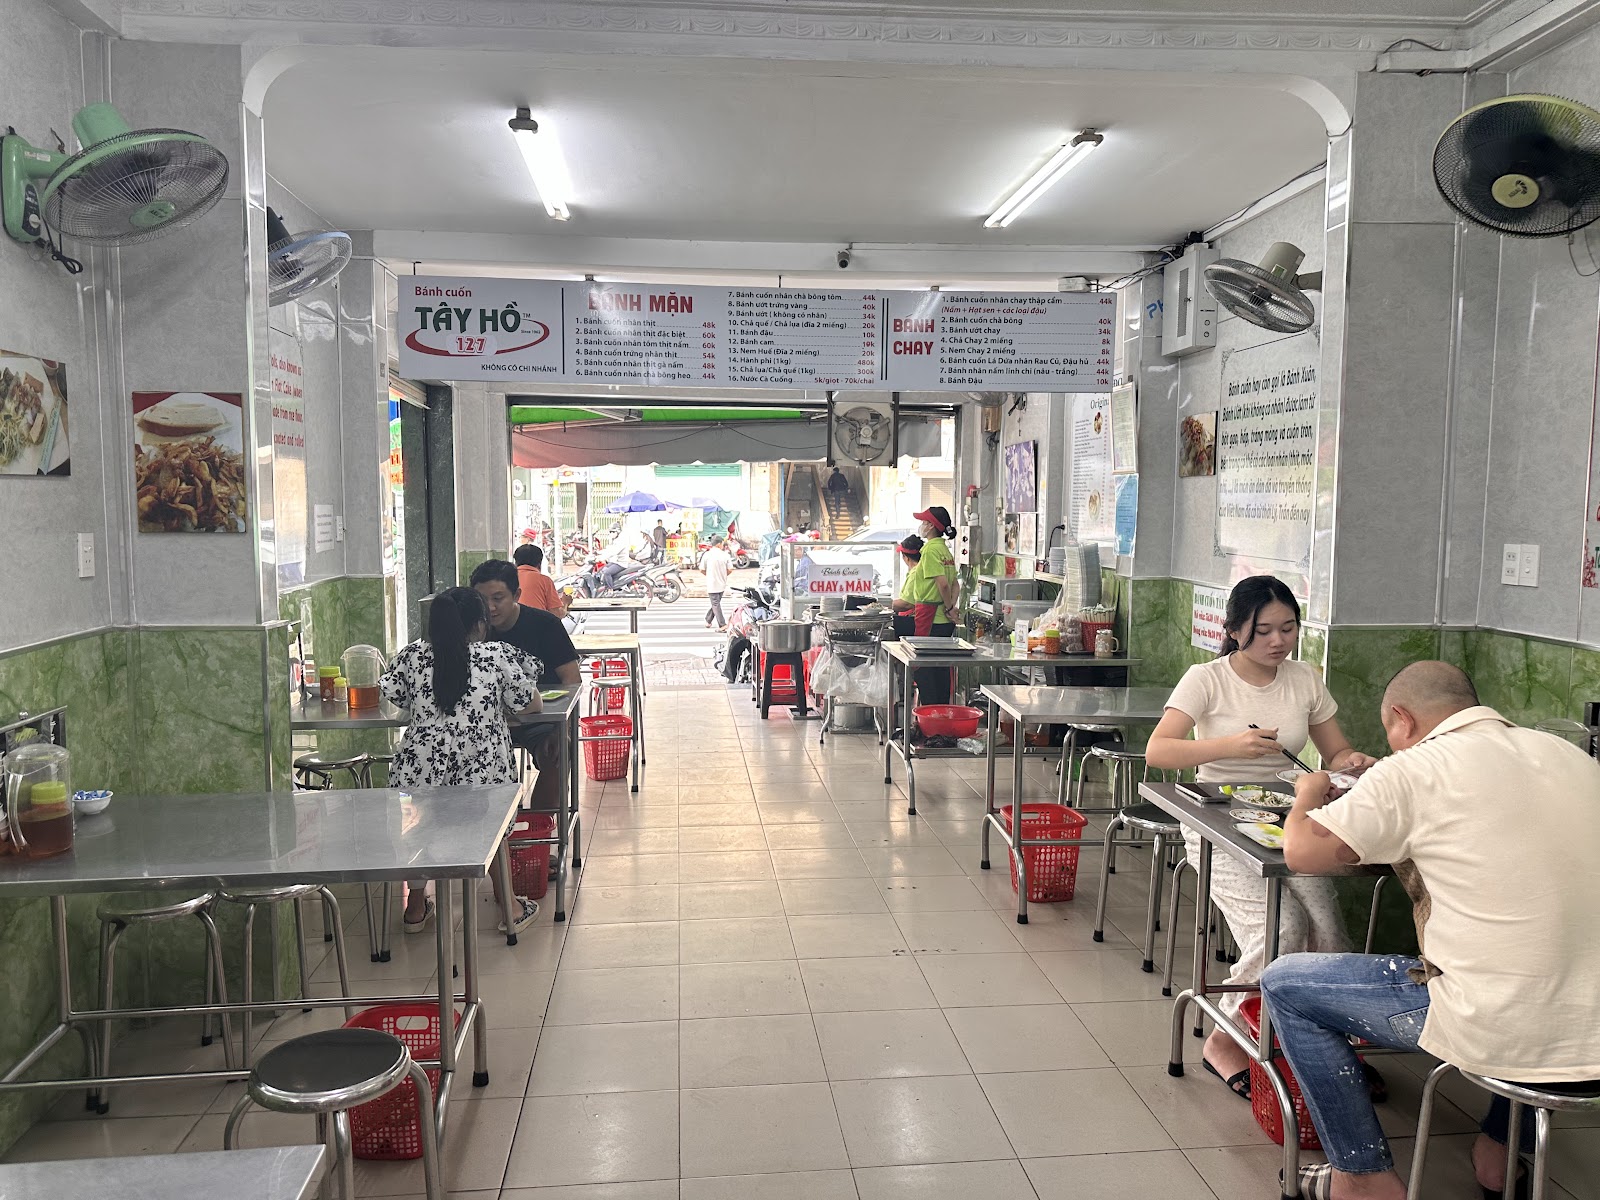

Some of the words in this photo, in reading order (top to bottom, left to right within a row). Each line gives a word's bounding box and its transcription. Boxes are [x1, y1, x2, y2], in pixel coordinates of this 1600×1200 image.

[415, 286, 443, 297] Bánh
[446, 286, 472, 297] cuốn
[755, 291, 773, 299] cuốn
[971, 294, 988, 303] cuốn
[649, 292, 693, 316] MẶN
[414, 302, 472, 333] TÂY
[480, 301, 520, 334] HỒ
[970, 316, 987, 324] cuốn
[702, 321, 716, 329] 48k
[893, 313, 935, 333] BÁNH
[702, 331, 716, 339] 60k
[456, 336, 487, 353] 127
[604, 338, 621, 346] cuốn
[584, 348, 602, 356] Bánh
[604, 348, 621, 357] cuốn
[893, 341, 934, 355] CHAY
[584, 358, 602, 366] Bánh
[604, 358, 621, 367] cuốn
[508, 364, 518, 372] CÓ
[532, 364, 557, 373] NHÁNH
[604, 368, 621, 377] cuốn
[1287, 368, 1299, 385] Bánh
[810, 580, 838, 592] CHAY
[845, 578, 872, 593] MẶN
